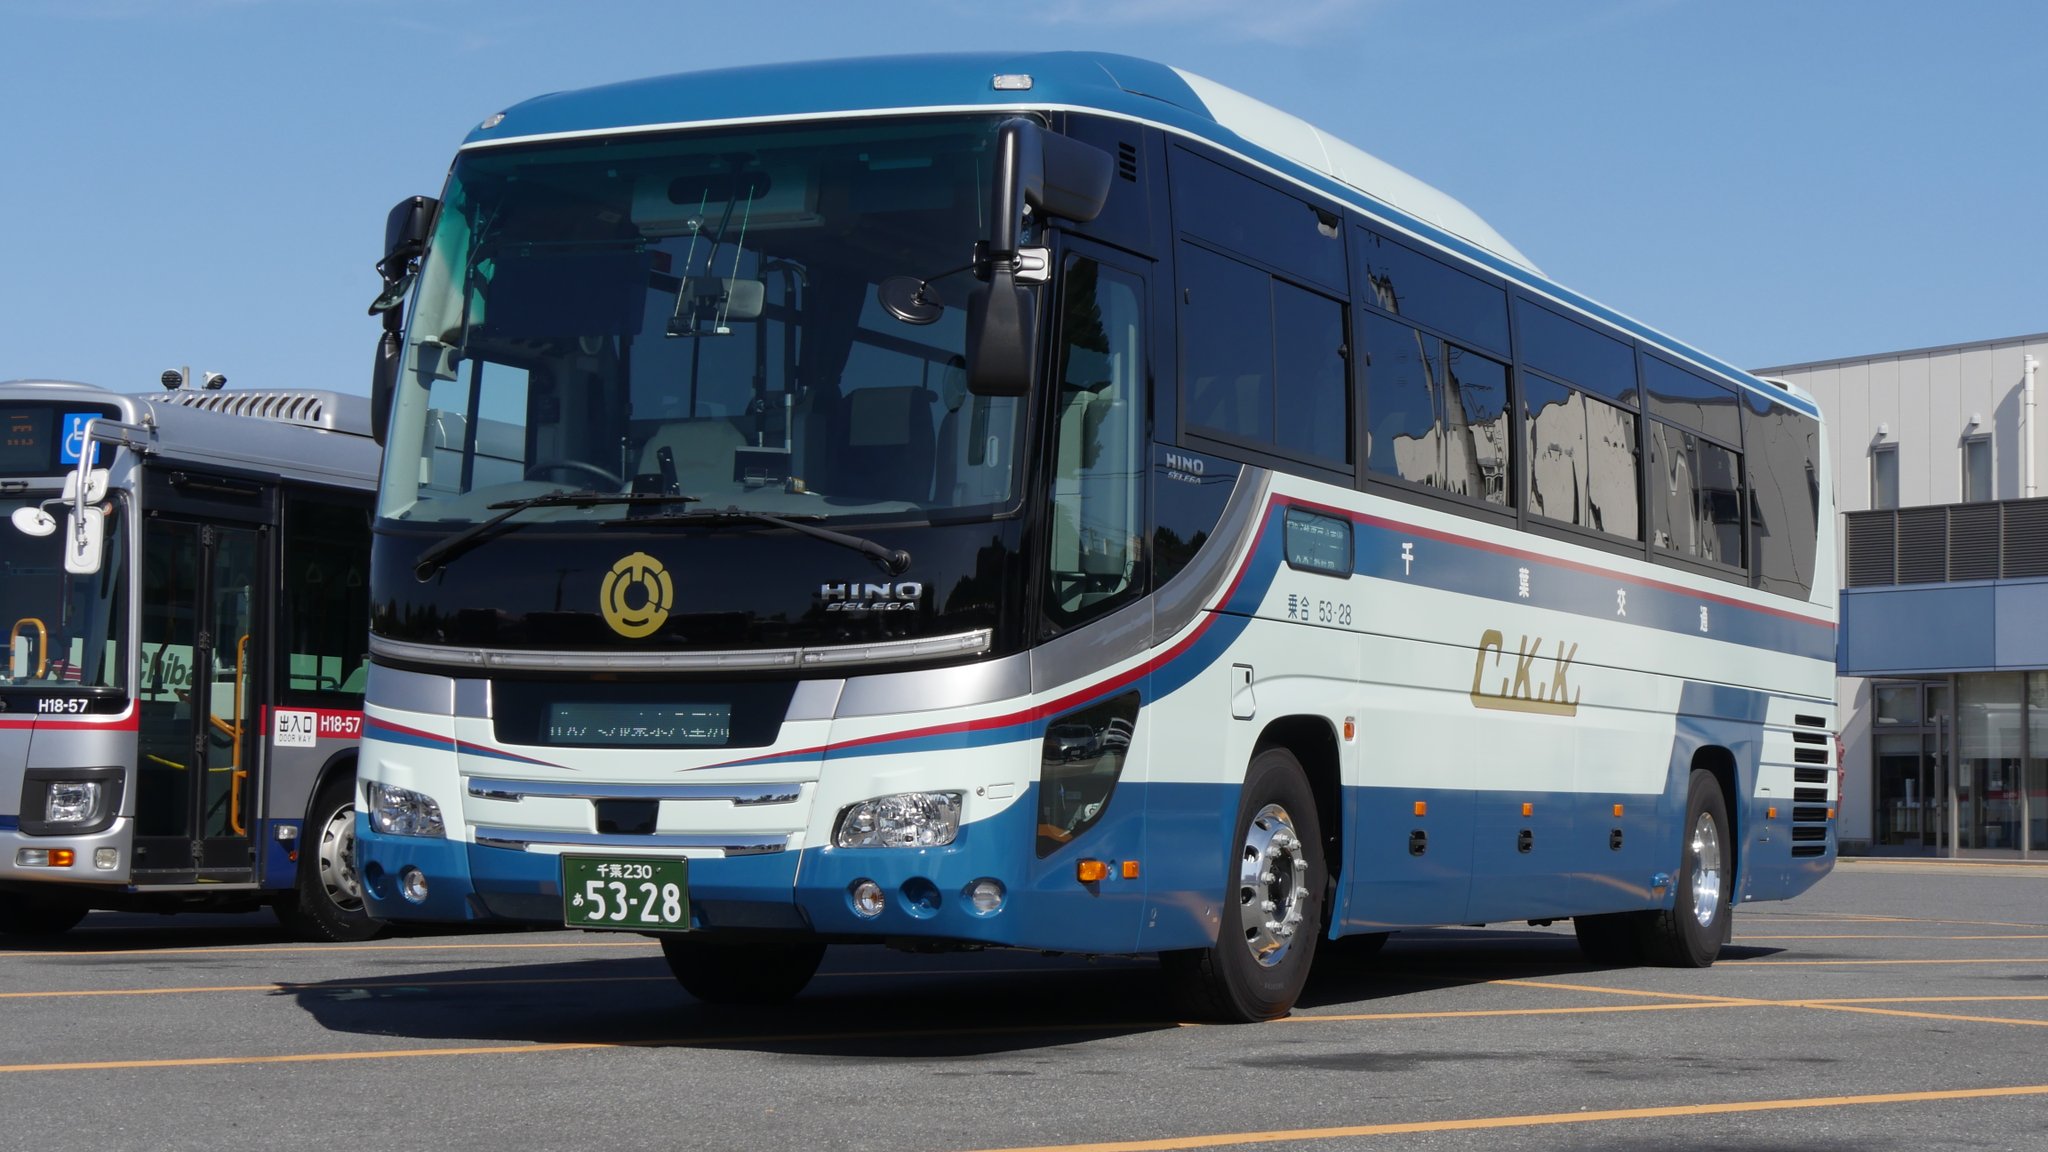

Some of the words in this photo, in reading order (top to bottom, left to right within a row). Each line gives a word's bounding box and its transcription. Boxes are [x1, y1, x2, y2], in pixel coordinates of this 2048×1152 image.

[1166, 452, 1204, 476] HINO
[821, 582, 923, 600] HINO
[1288, 594, 1310, 621] 乗合
[1319, 600, 1352, 626] 53-28
[38, 698, 89, 713] H18-57
[279, 714, 312, 733] 出入口
[320, 715, 361, 733] H18-57
[572, 892, 584, 907] あ
[586, 880, 682, 923] 53-28
